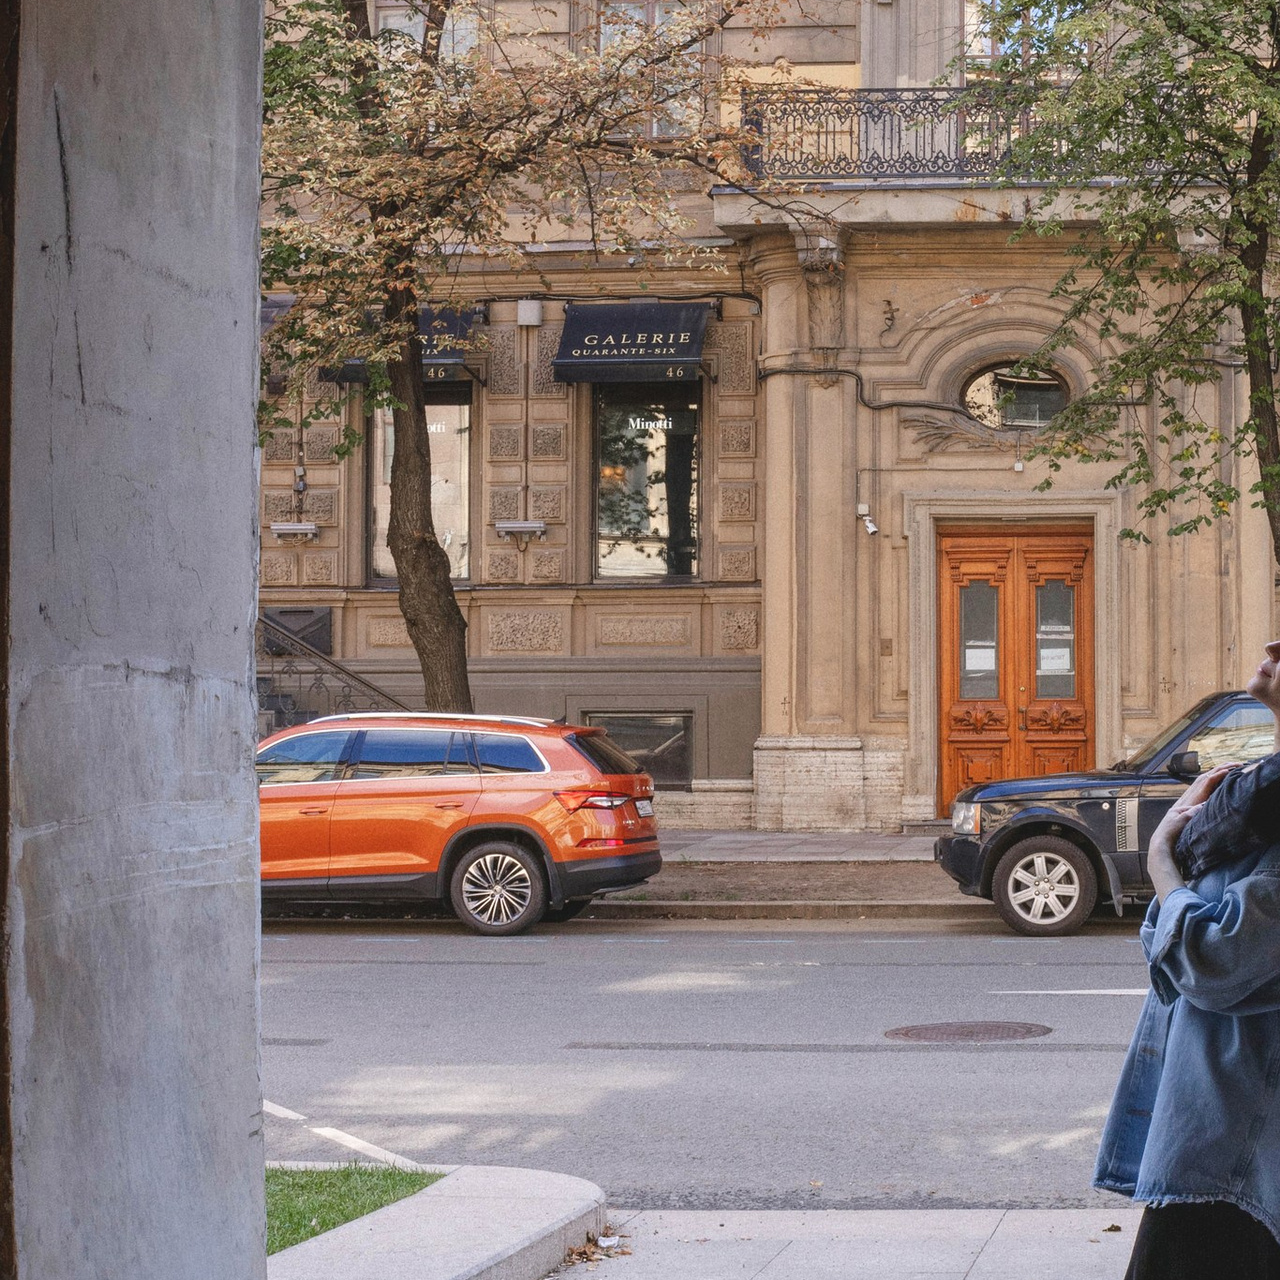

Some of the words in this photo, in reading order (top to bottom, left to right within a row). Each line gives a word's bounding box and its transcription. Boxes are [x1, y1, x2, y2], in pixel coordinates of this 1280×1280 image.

[584, 332, 691, 345] GALERIE
[572, 348, 676, 356] QUARANTE-SIX
[427, 367, 445, 379] 46
[666, 367, 684, 378] 46
[427, 421, 446, 433] otti
[628, 417, 673, 430] Minotti
